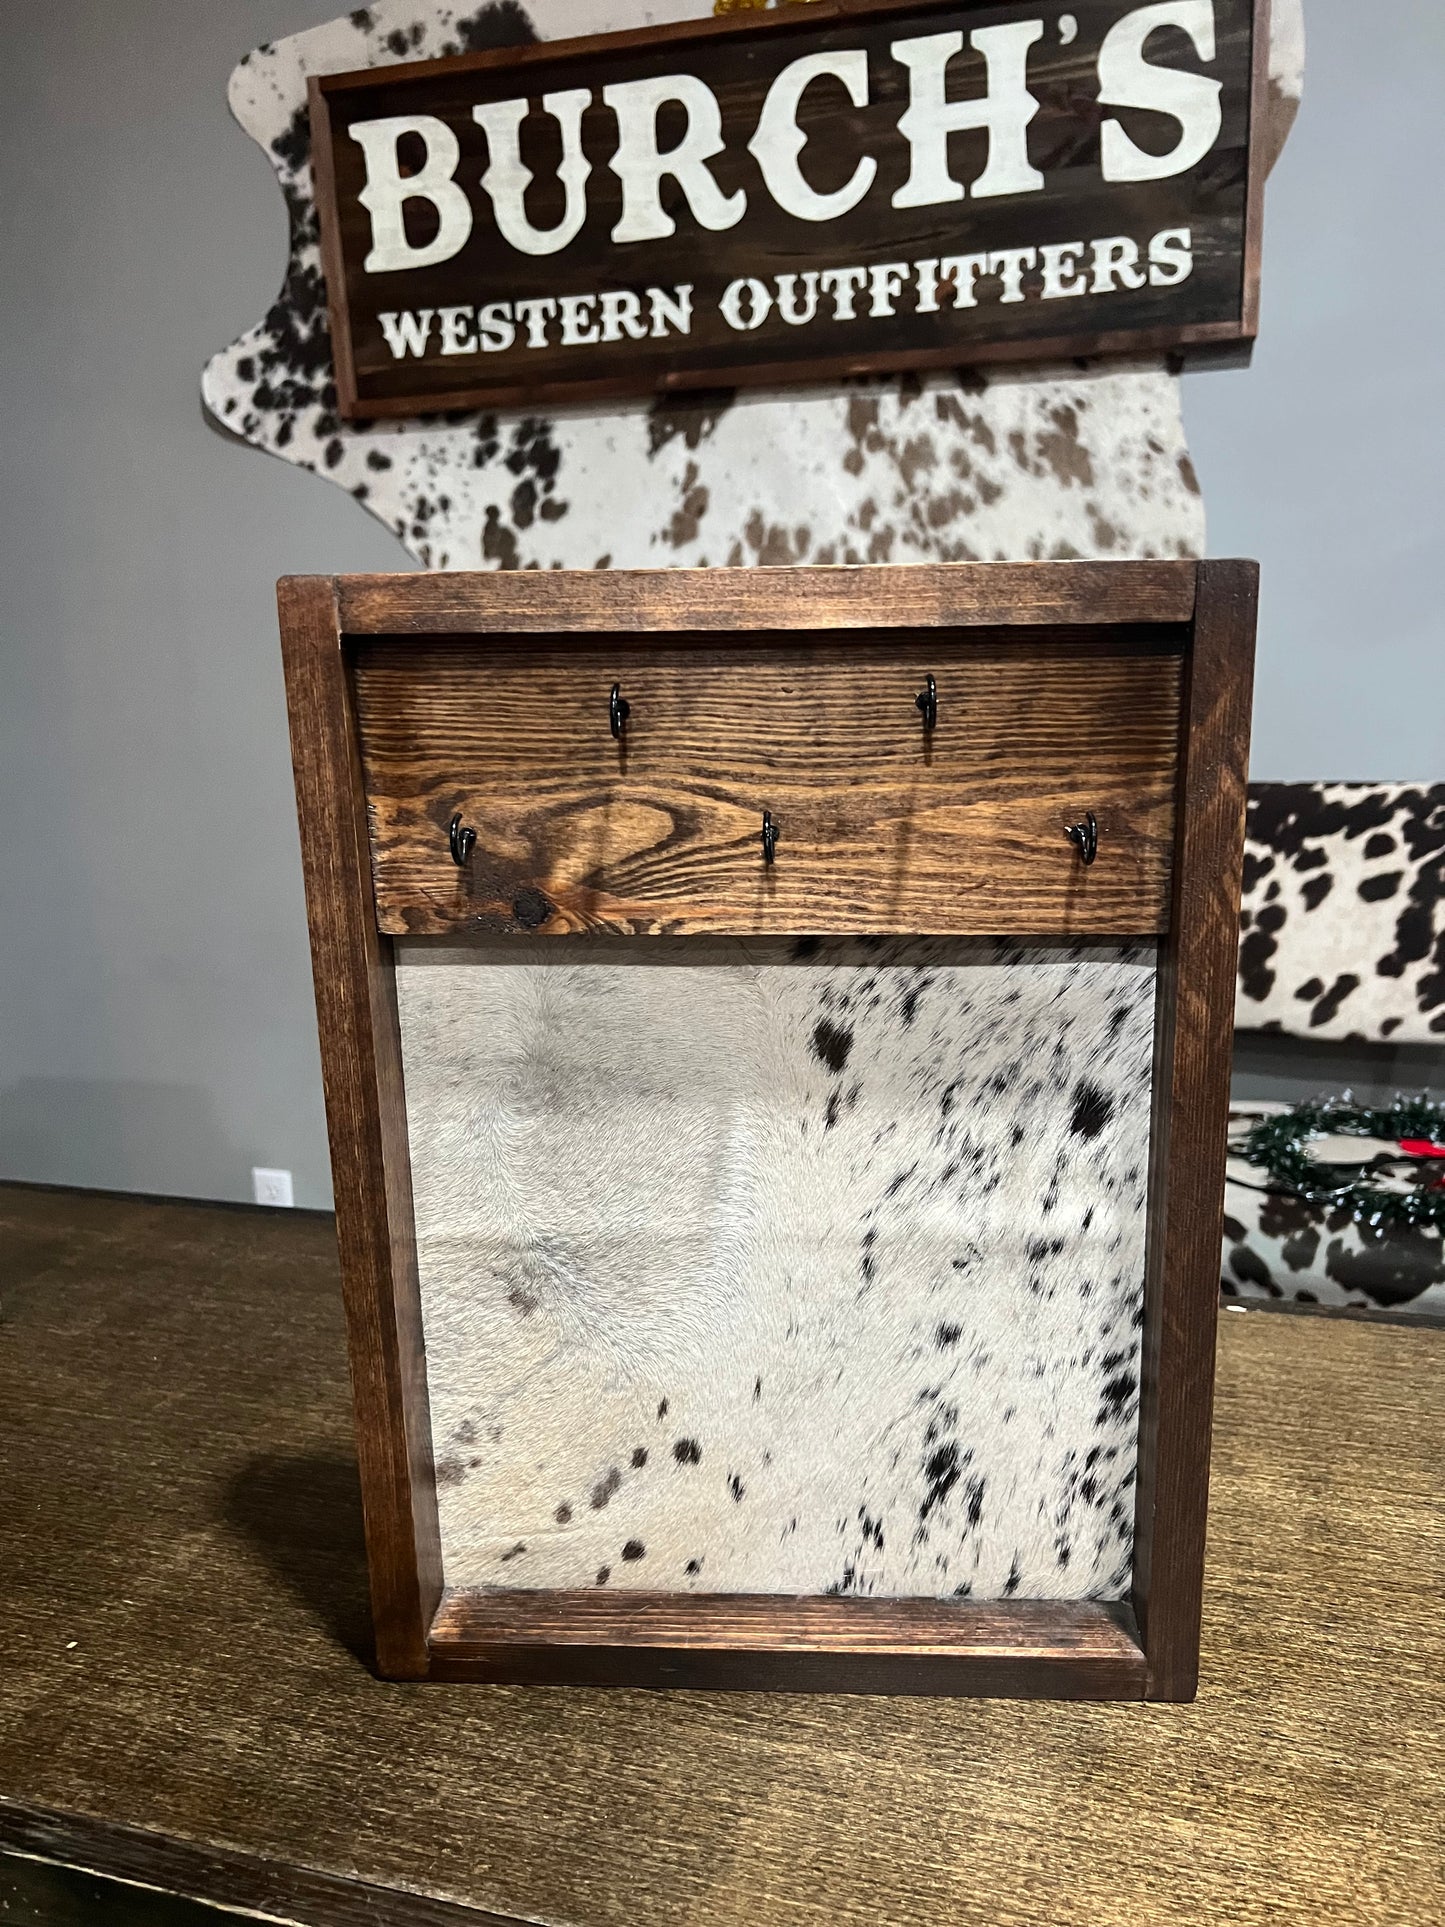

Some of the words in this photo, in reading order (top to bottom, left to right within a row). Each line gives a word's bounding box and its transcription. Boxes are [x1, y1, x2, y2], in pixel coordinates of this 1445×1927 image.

[348, 0, 1224, 273] BURCH'S
[378, 284, 694, 359] WESTERN
[718, 227, 1194, 331] OUTFITTERS
